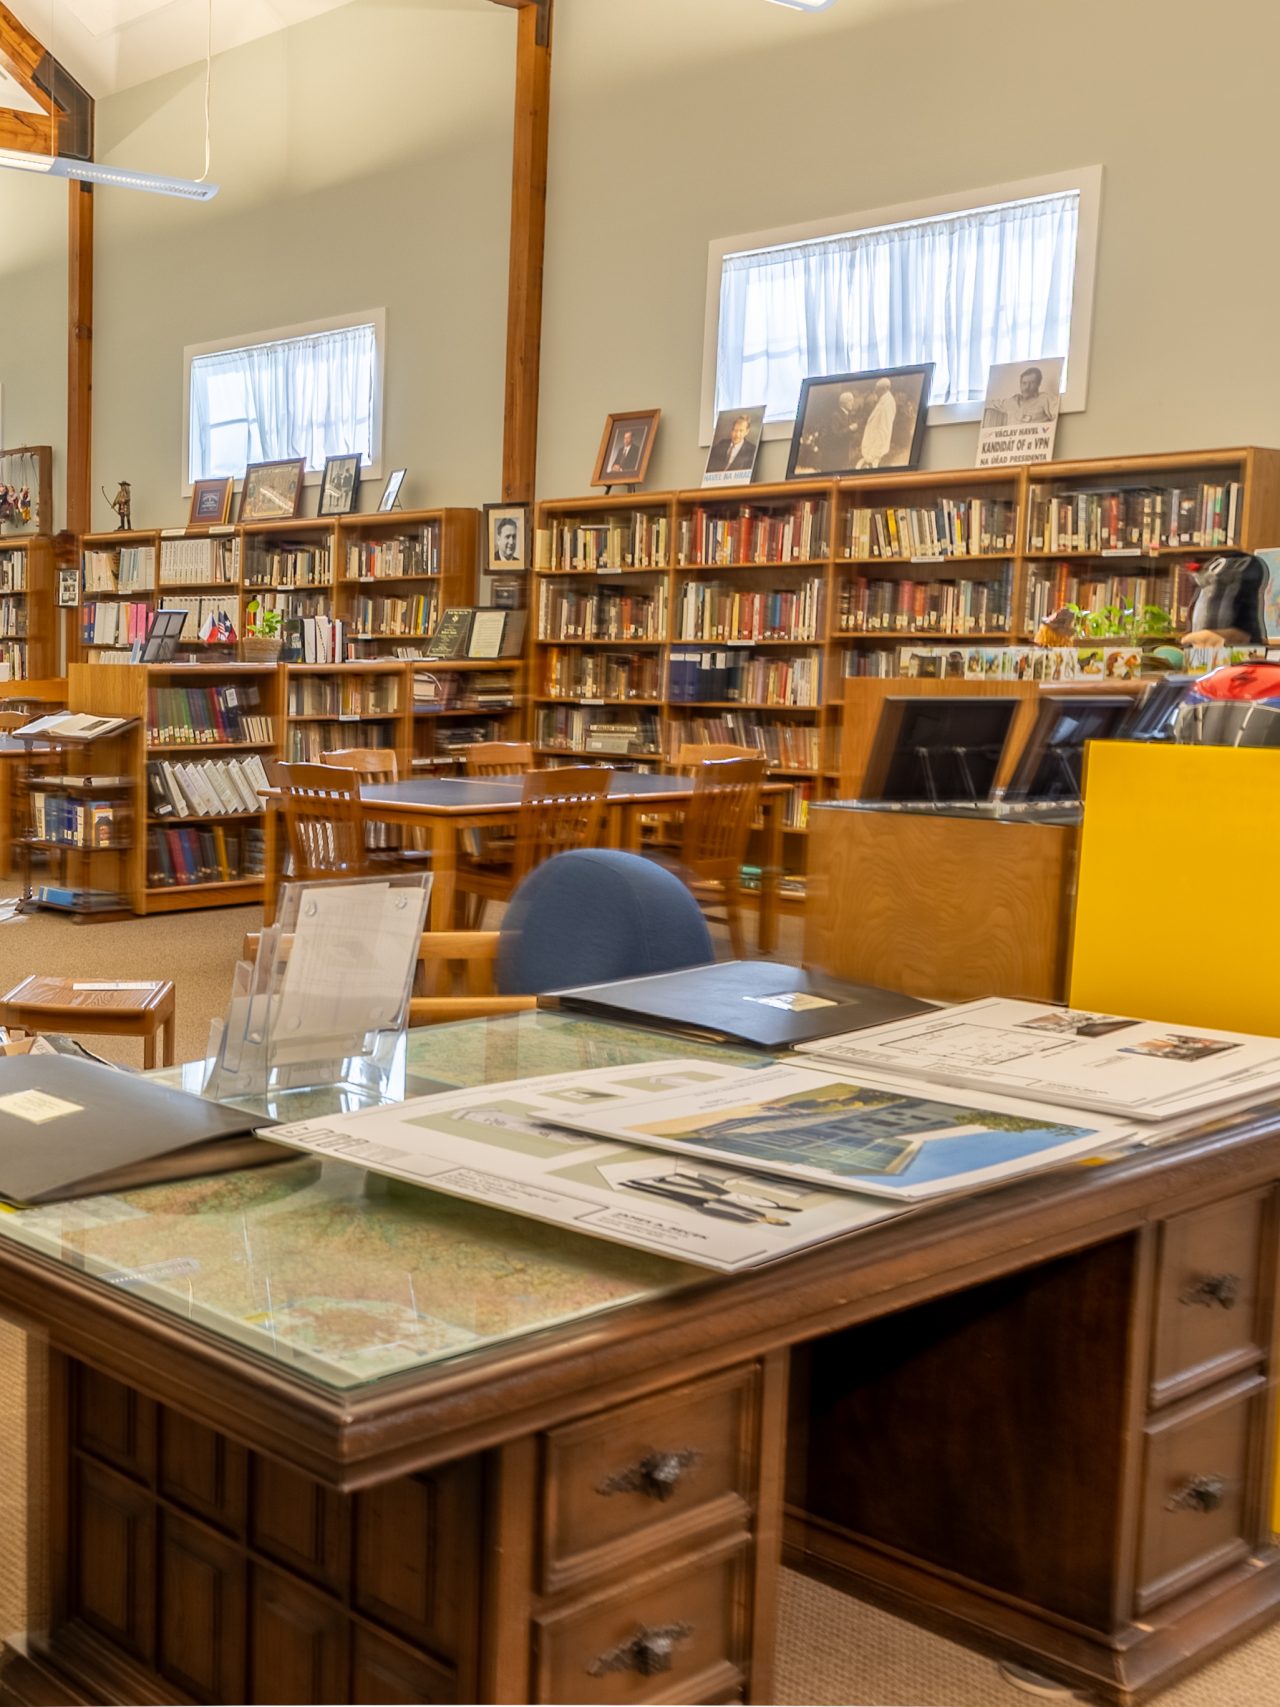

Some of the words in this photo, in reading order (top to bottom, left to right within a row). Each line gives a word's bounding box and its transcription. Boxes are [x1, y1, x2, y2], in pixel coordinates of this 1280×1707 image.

[1019, 427, 1039, 436] HAVEL
[1016, 439, 1026, 451] OF
[1034, 437, 1050, 449] VPN
